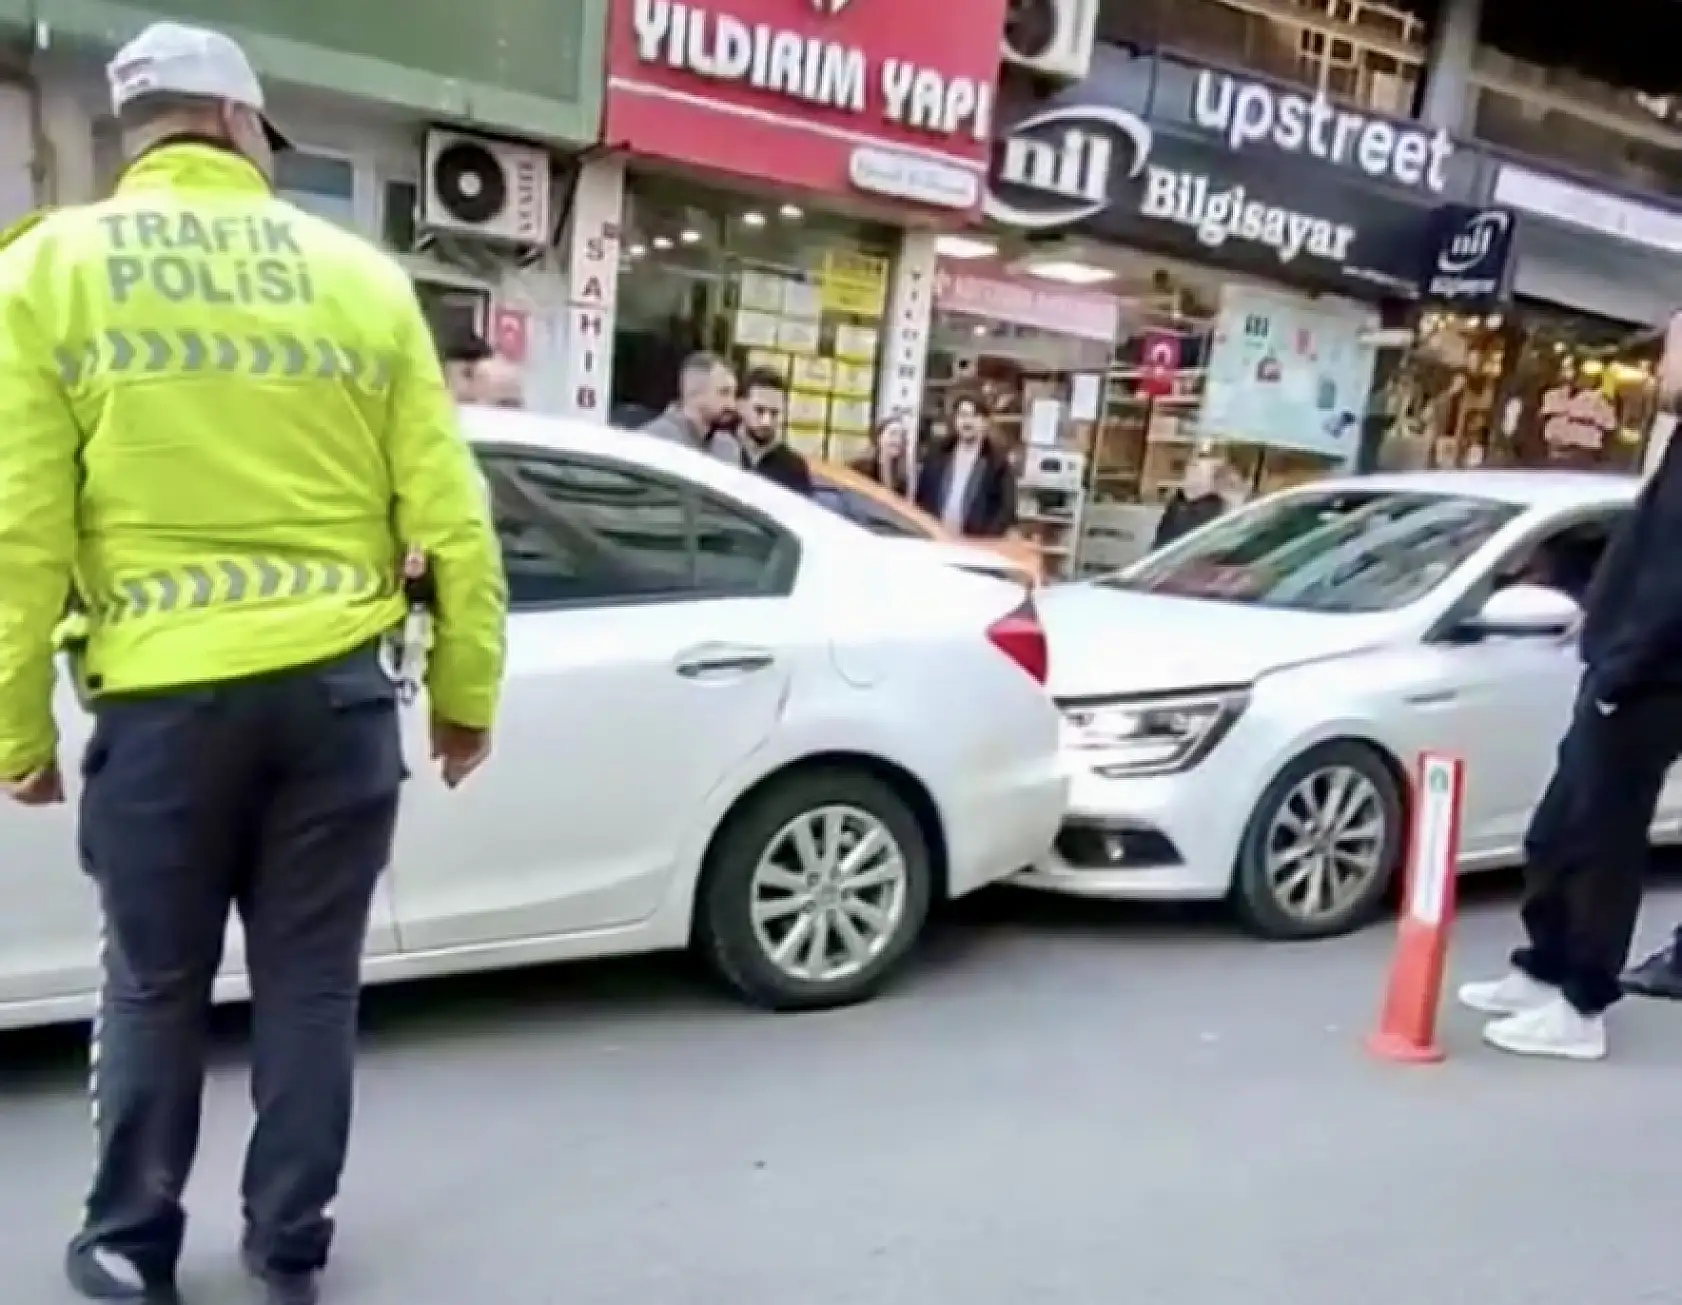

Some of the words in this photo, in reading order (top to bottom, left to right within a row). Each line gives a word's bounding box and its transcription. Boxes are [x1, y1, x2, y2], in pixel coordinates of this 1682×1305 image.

[634, 0, 867, 112] YILDIRIM
[883, 59, 990, 140] YAPI
[1001, 131, 1110, 200] nil
[1195, 70, 1453, 191] upstreet
[1141, 166, 1355, 261] Bilgisayar
